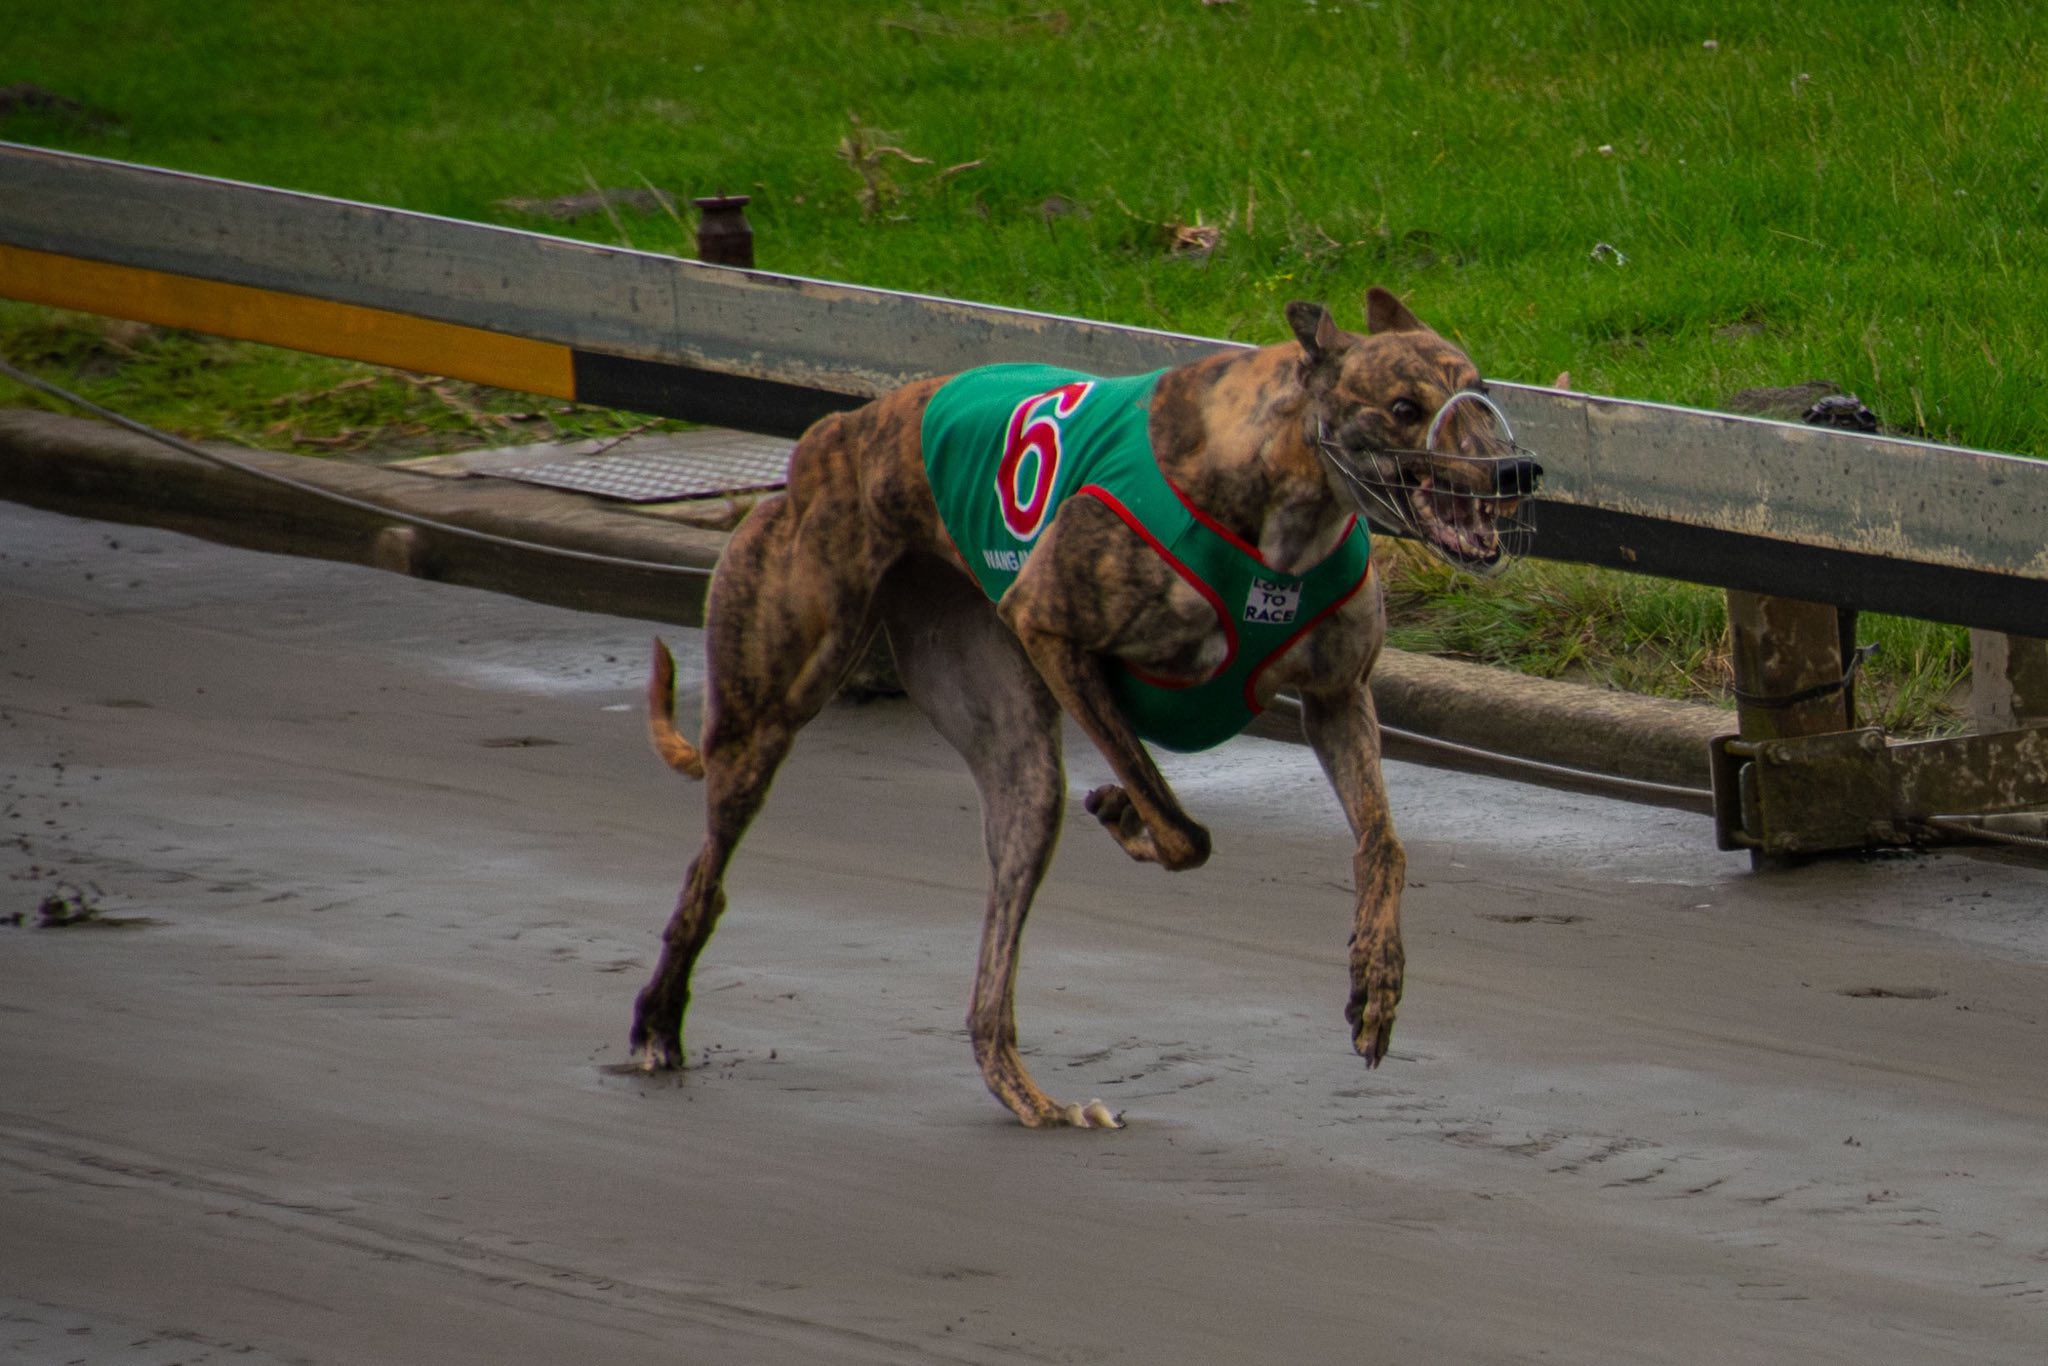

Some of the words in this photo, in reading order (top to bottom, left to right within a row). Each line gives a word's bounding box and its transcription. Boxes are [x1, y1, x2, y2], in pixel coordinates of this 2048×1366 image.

[994, 381, 1094, 542] 6
[1262, 592, 1286, 606] TO
[1245, 605, 1295, 622] RACE
